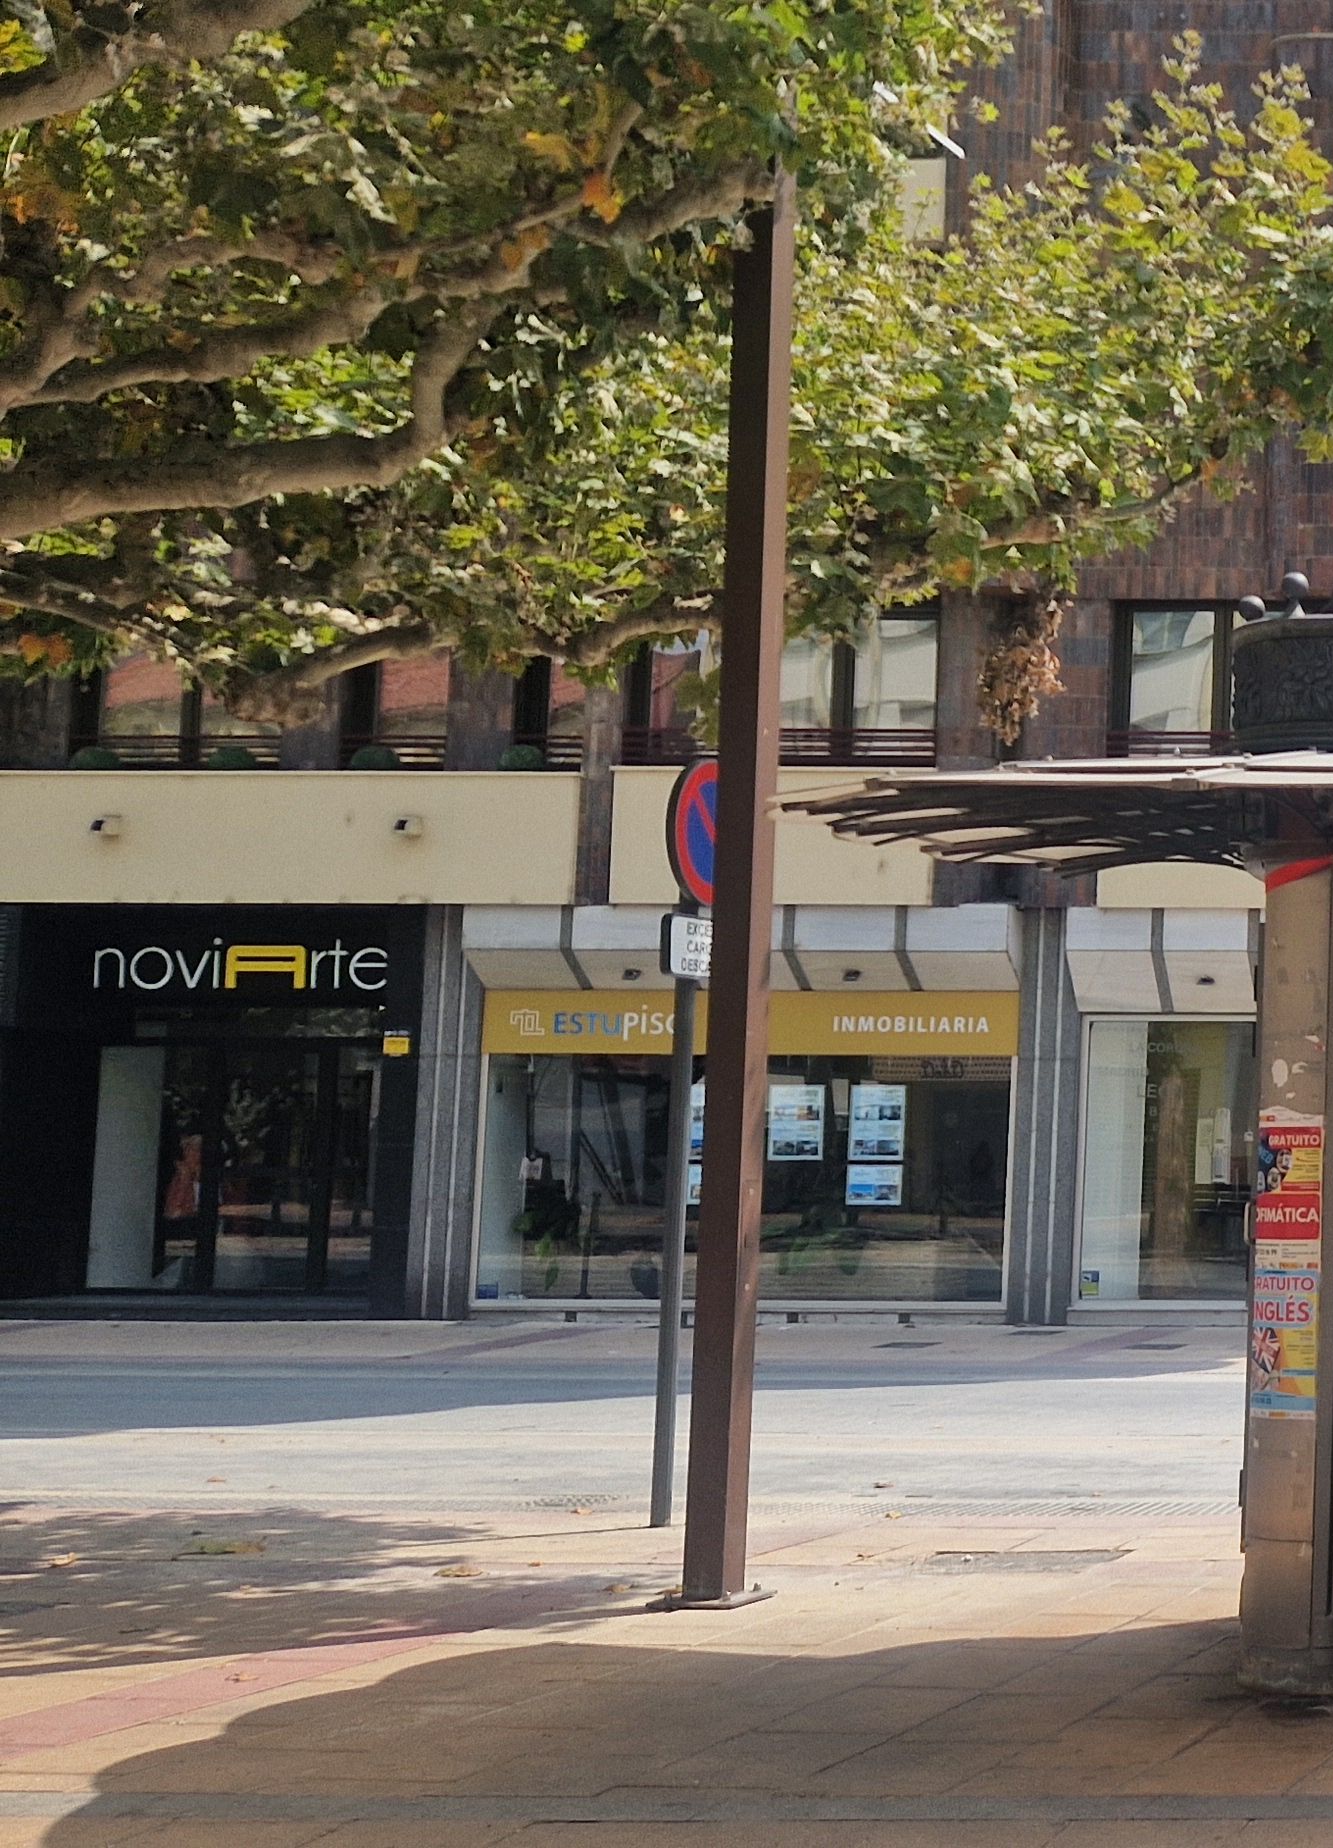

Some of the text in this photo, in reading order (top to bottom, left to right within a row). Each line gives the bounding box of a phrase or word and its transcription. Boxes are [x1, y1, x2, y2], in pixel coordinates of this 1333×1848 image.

[93, 937, 389, 990] noviArte
[680, 957, 709, 973] DESC
[832, 1015, 990, 1033] INMOBILIARIA
[1268, 1134, 1320, 1147] GRATUITO
[1255, 1276, 1315, 1291] RATUITO
[1254, 1295, 1311, 1322] NGLÉS
